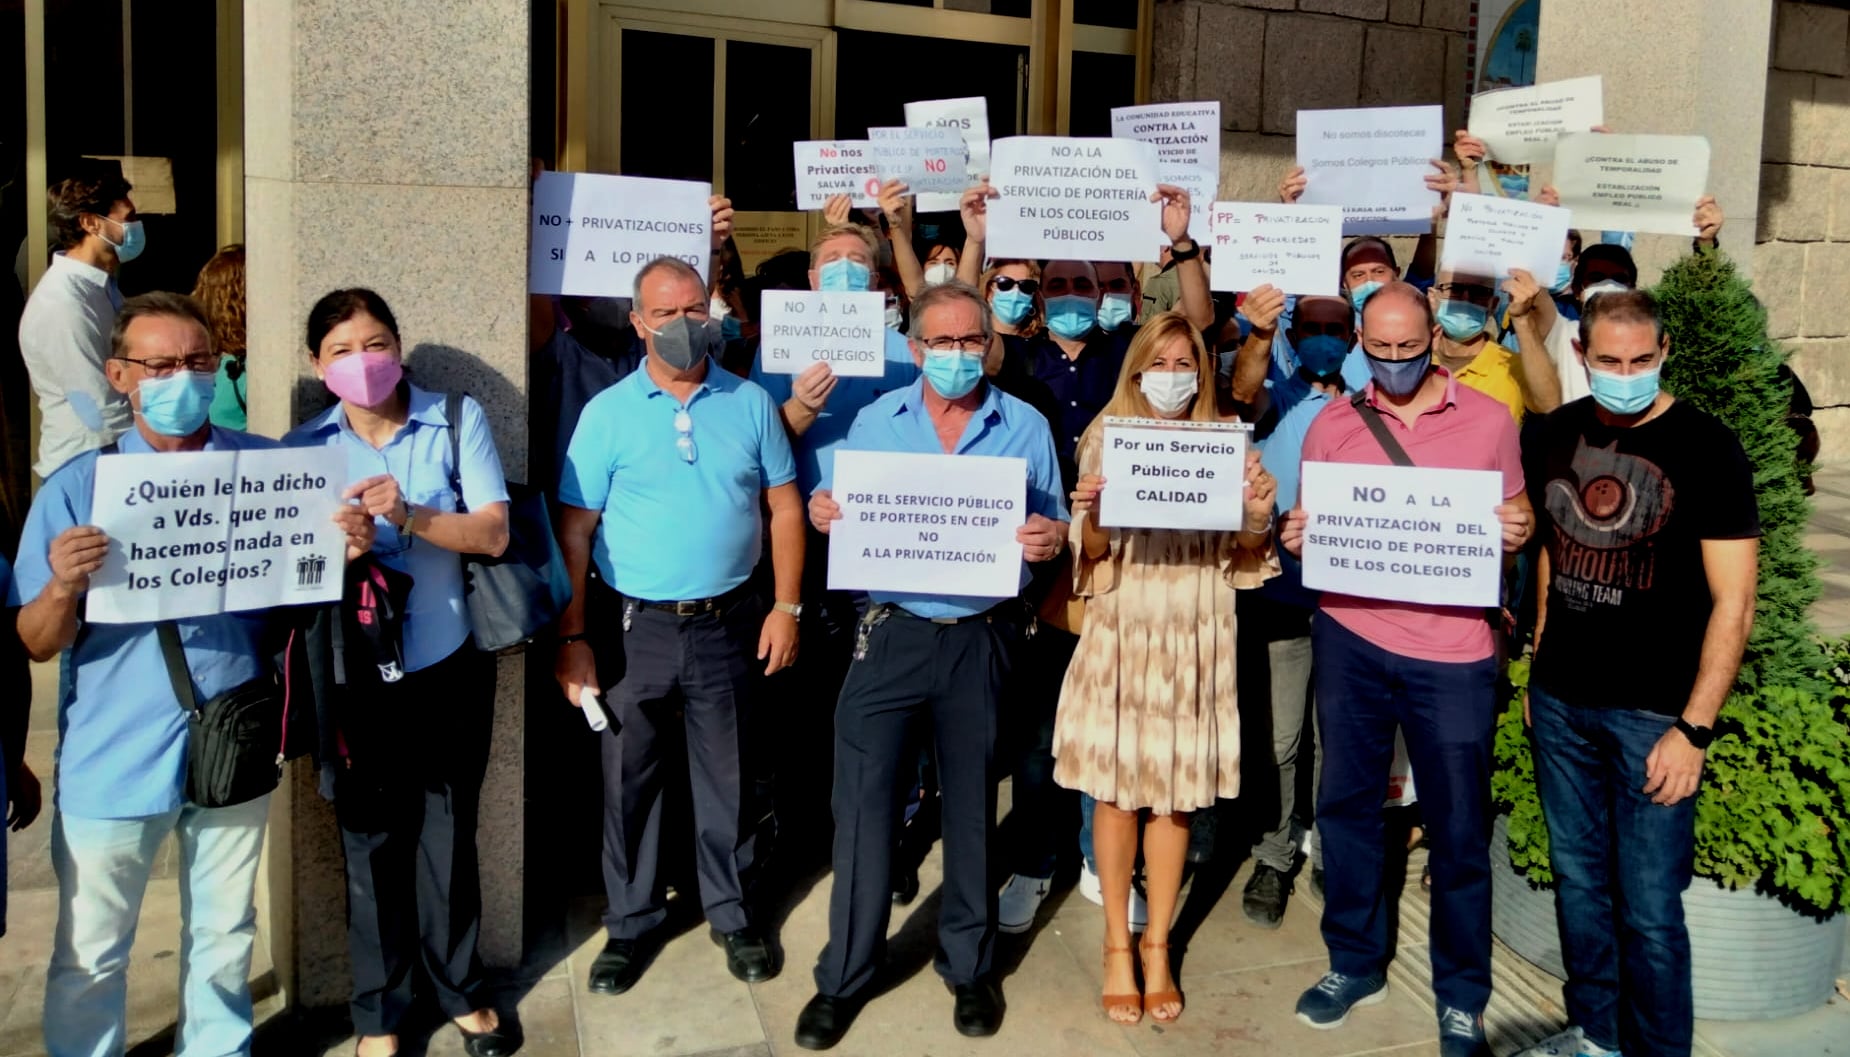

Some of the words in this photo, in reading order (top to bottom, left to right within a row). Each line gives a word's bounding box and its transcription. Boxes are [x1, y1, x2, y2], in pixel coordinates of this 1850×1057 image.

[1126, 112, 1170, 120] COMUNIDAD
[1133, 122, 1177, 133] CONTRA
[1181, 122, 1195, 130] LA
[1322, 131, 1336, 140] No
[1374, 130, 1425, 138] discotecas
[820, 148, 837, 158] No
[841, 149, 862, 158] nos
[1051, 146, 1071, 158] NO
[1076, 147, 1086, 158] A
[1087, 147, 1101, 158] LA
[924, 158, 946, 172] NO
[1014, 162, 1112, 179] PRIVATIZACIÓN
[1116, 169, 1138, 180] DEL
[1312, 158, 1344, 168] Somos
[1347, 158, 1388, 168] Colegios
[818, 180, 846, 188] SALVA
[1003, 185, 1061, 198] SERVICIO
[1064, 187, 1082, 199] DE
[1084, 184, 1147, 200] PORTERÍA
[1019, 207, 1036, 218] EN
[1040, 207, 1063, 219] LOS
[1067, 208, 1129, 221] COLEGIOS
[539, 214, 562, 226] NO
[582, 216, 703, 234] PRIVATIZACIONES
[1043, 225, 1104, 241] PÚBLICOS
[551, 248, 564, 260] SI
[584, 250, 595, 262] A
[612, 251, 631, 264] LO
[784, 300, 805, 314] NO
[818, 301, 828, 314] A
[842, 302, 857, 315] LA
[773, 323, 871, 339] PRIVATIZACIÓN
[772, 348, 790, 360] EN
[811, 348, 875, 362] COLEGIOS
[1114, 438, 1140, 451] Por
[1145, 442, 1165, 452] un
[1171, 440, 1235, 455] Servicio
[1132, 464, 1190, 479] Público
[1196, 468, 1215, 479] de
[124, 478, 205, 506] ¿Quién
[214, 477, 233, 496] le
[240, 476, 265, 495] ha
[272, 473, 327, 493] dicho
[1136, 490, 1207, 504] CALIDAD
[1352, 487, 1386, 503] NO
[1406, 494, 1416, 506] A
[1431, 496, 1451, 508] LA
[847, 492, 873, 505] POR
[877, 493, 892, 505] EL
[894, 494, 953, 507] SERVICIO
[958, 493, 1014, 510] PÚBLICO
[152, 513, 166, 529] a
[174, 508, 220, 528] Vds.
[229, 508, 269, 526] que
[274, 506, 300, 520] no
[860, 512, 876, 522] DE
[880, 512, 947, 525] PORTEROS
[951, 515, 967, 526] EN
[971, 516, 999, 527] CEIP
[1317, 513, 1441, 533] PRIVATIZACIÓN
[1456, 523, 1487, 536] DEL
[130, 539, 227, 560] hacemos
[233, 531, 283, 552] nada
[290, 532, 315, 546] en
[919, 532, 939, 543] NO
[1309, 534, 1383, 552] SERVICIO
[1388, 540, 1409, 552] DE
[1413, 542, 1495, 558] PORTERÍA
[862, 548, 872, 558] A
[875, 548, 890, 559] LA
[894, 546, 996, 563] PRIVATIZACIÓN
[128, 572, 161, 590] los
[170, 559, 272, 586] Colegios?
[1329, 557, 1350, 568] DE
[1355, 559, 1385, 571] LOS
[1390, 563, 1472, 578] COLEGIOS
[1592, 584, 1622, 606] TEAM
